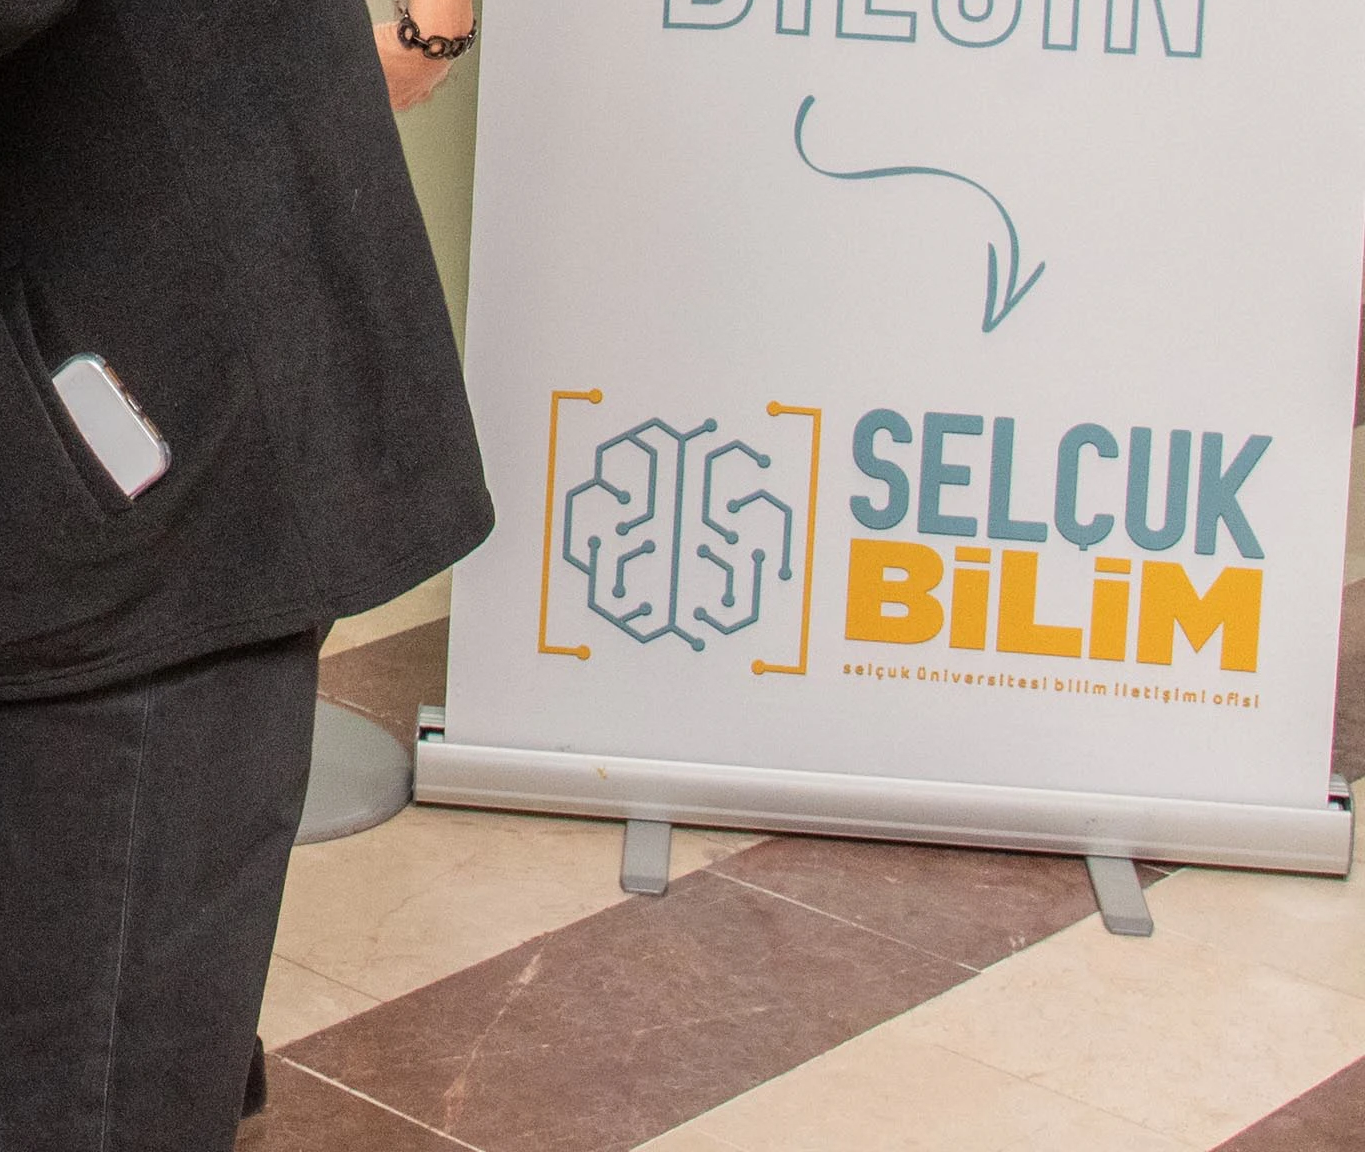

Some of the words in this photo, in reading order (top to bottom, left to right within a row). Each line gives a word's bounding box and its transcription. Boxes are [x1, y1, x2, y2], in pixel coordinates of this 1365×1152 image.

[849, 408, 1273, 559] SELÇUK
[843, 662, 910, 680] selçuk
[917, 667, 1046, 690] üniversitesi
[1054, 678, 1107, 696] bilim
[1114, 683, 1206, 704] iletişimi
[1213, 692, 1260, 709] ofisi
